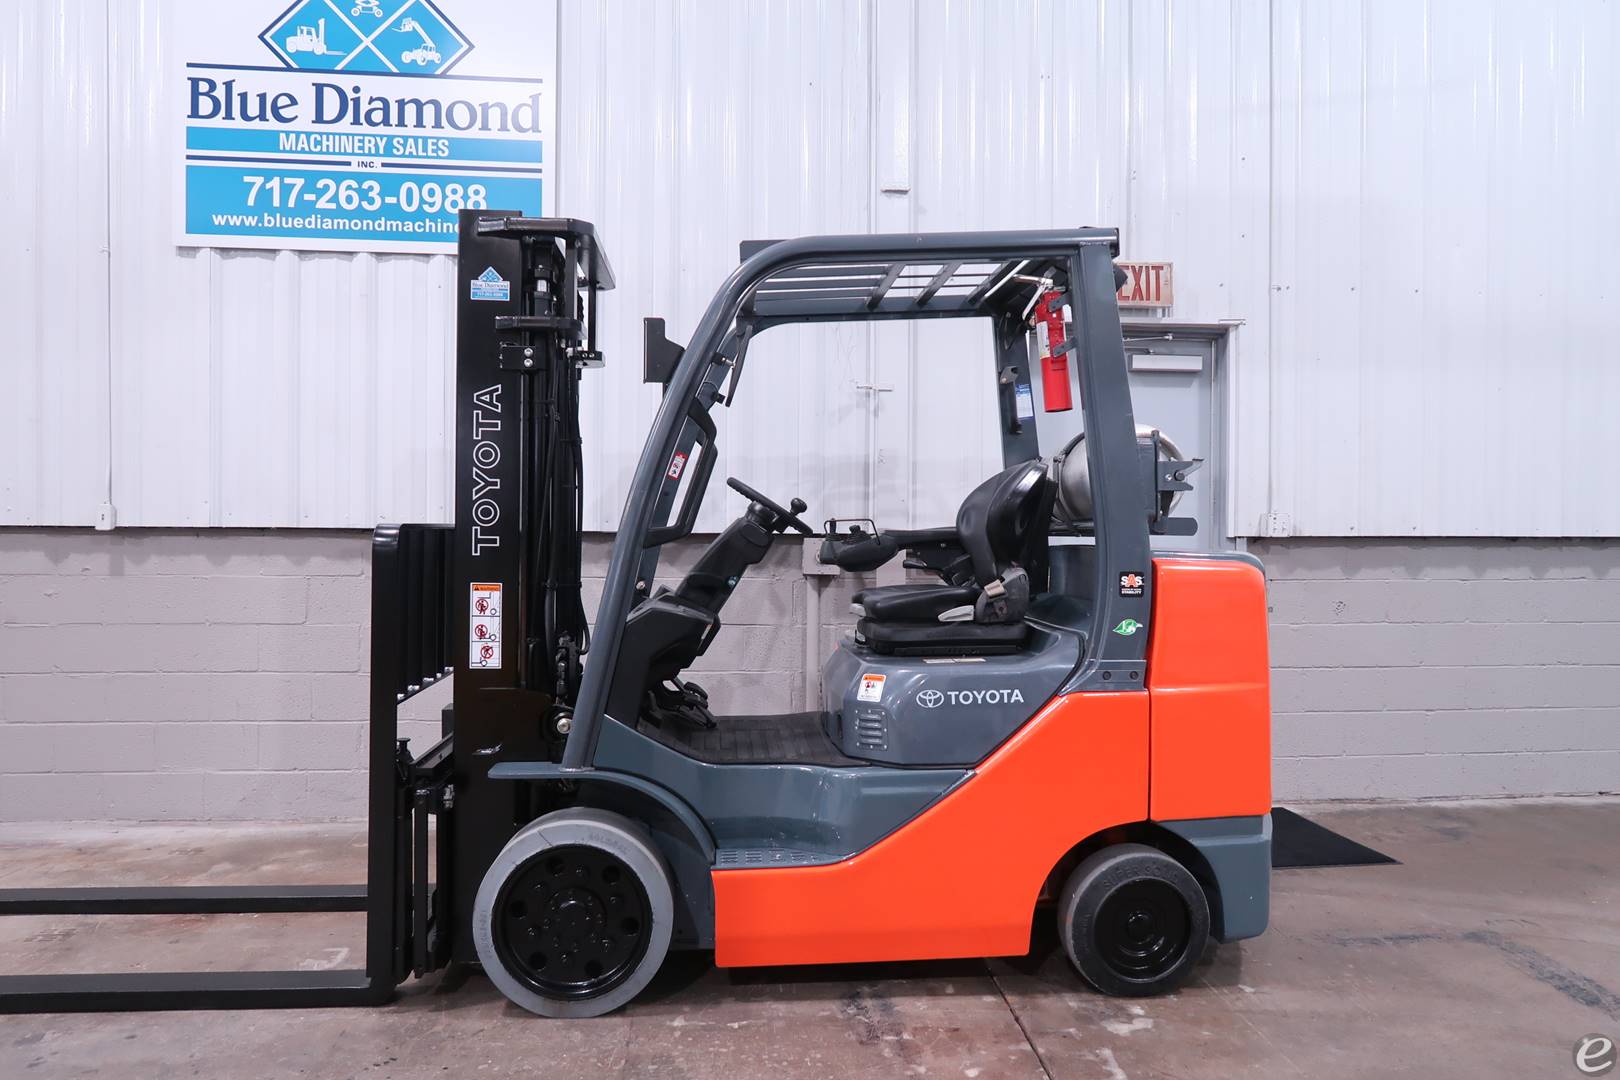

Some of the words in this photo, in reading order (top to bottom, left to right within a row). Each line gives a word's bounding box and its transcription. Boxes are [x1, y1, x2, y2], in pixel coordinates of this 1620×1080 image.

[187, 77, 299, 124] Blue
[311, 82, 543, 134] Diamond
[279, 132, 387, 155] MACHINERY
[392, 138, 449, 157] SALES
[357, 161, 378, 169] INC.
[243, 175, 487, 214] 717-263-0988
[472, 384, 501, 556] TOYOTA
[947, 689, 1024, 705] TOYOTA
